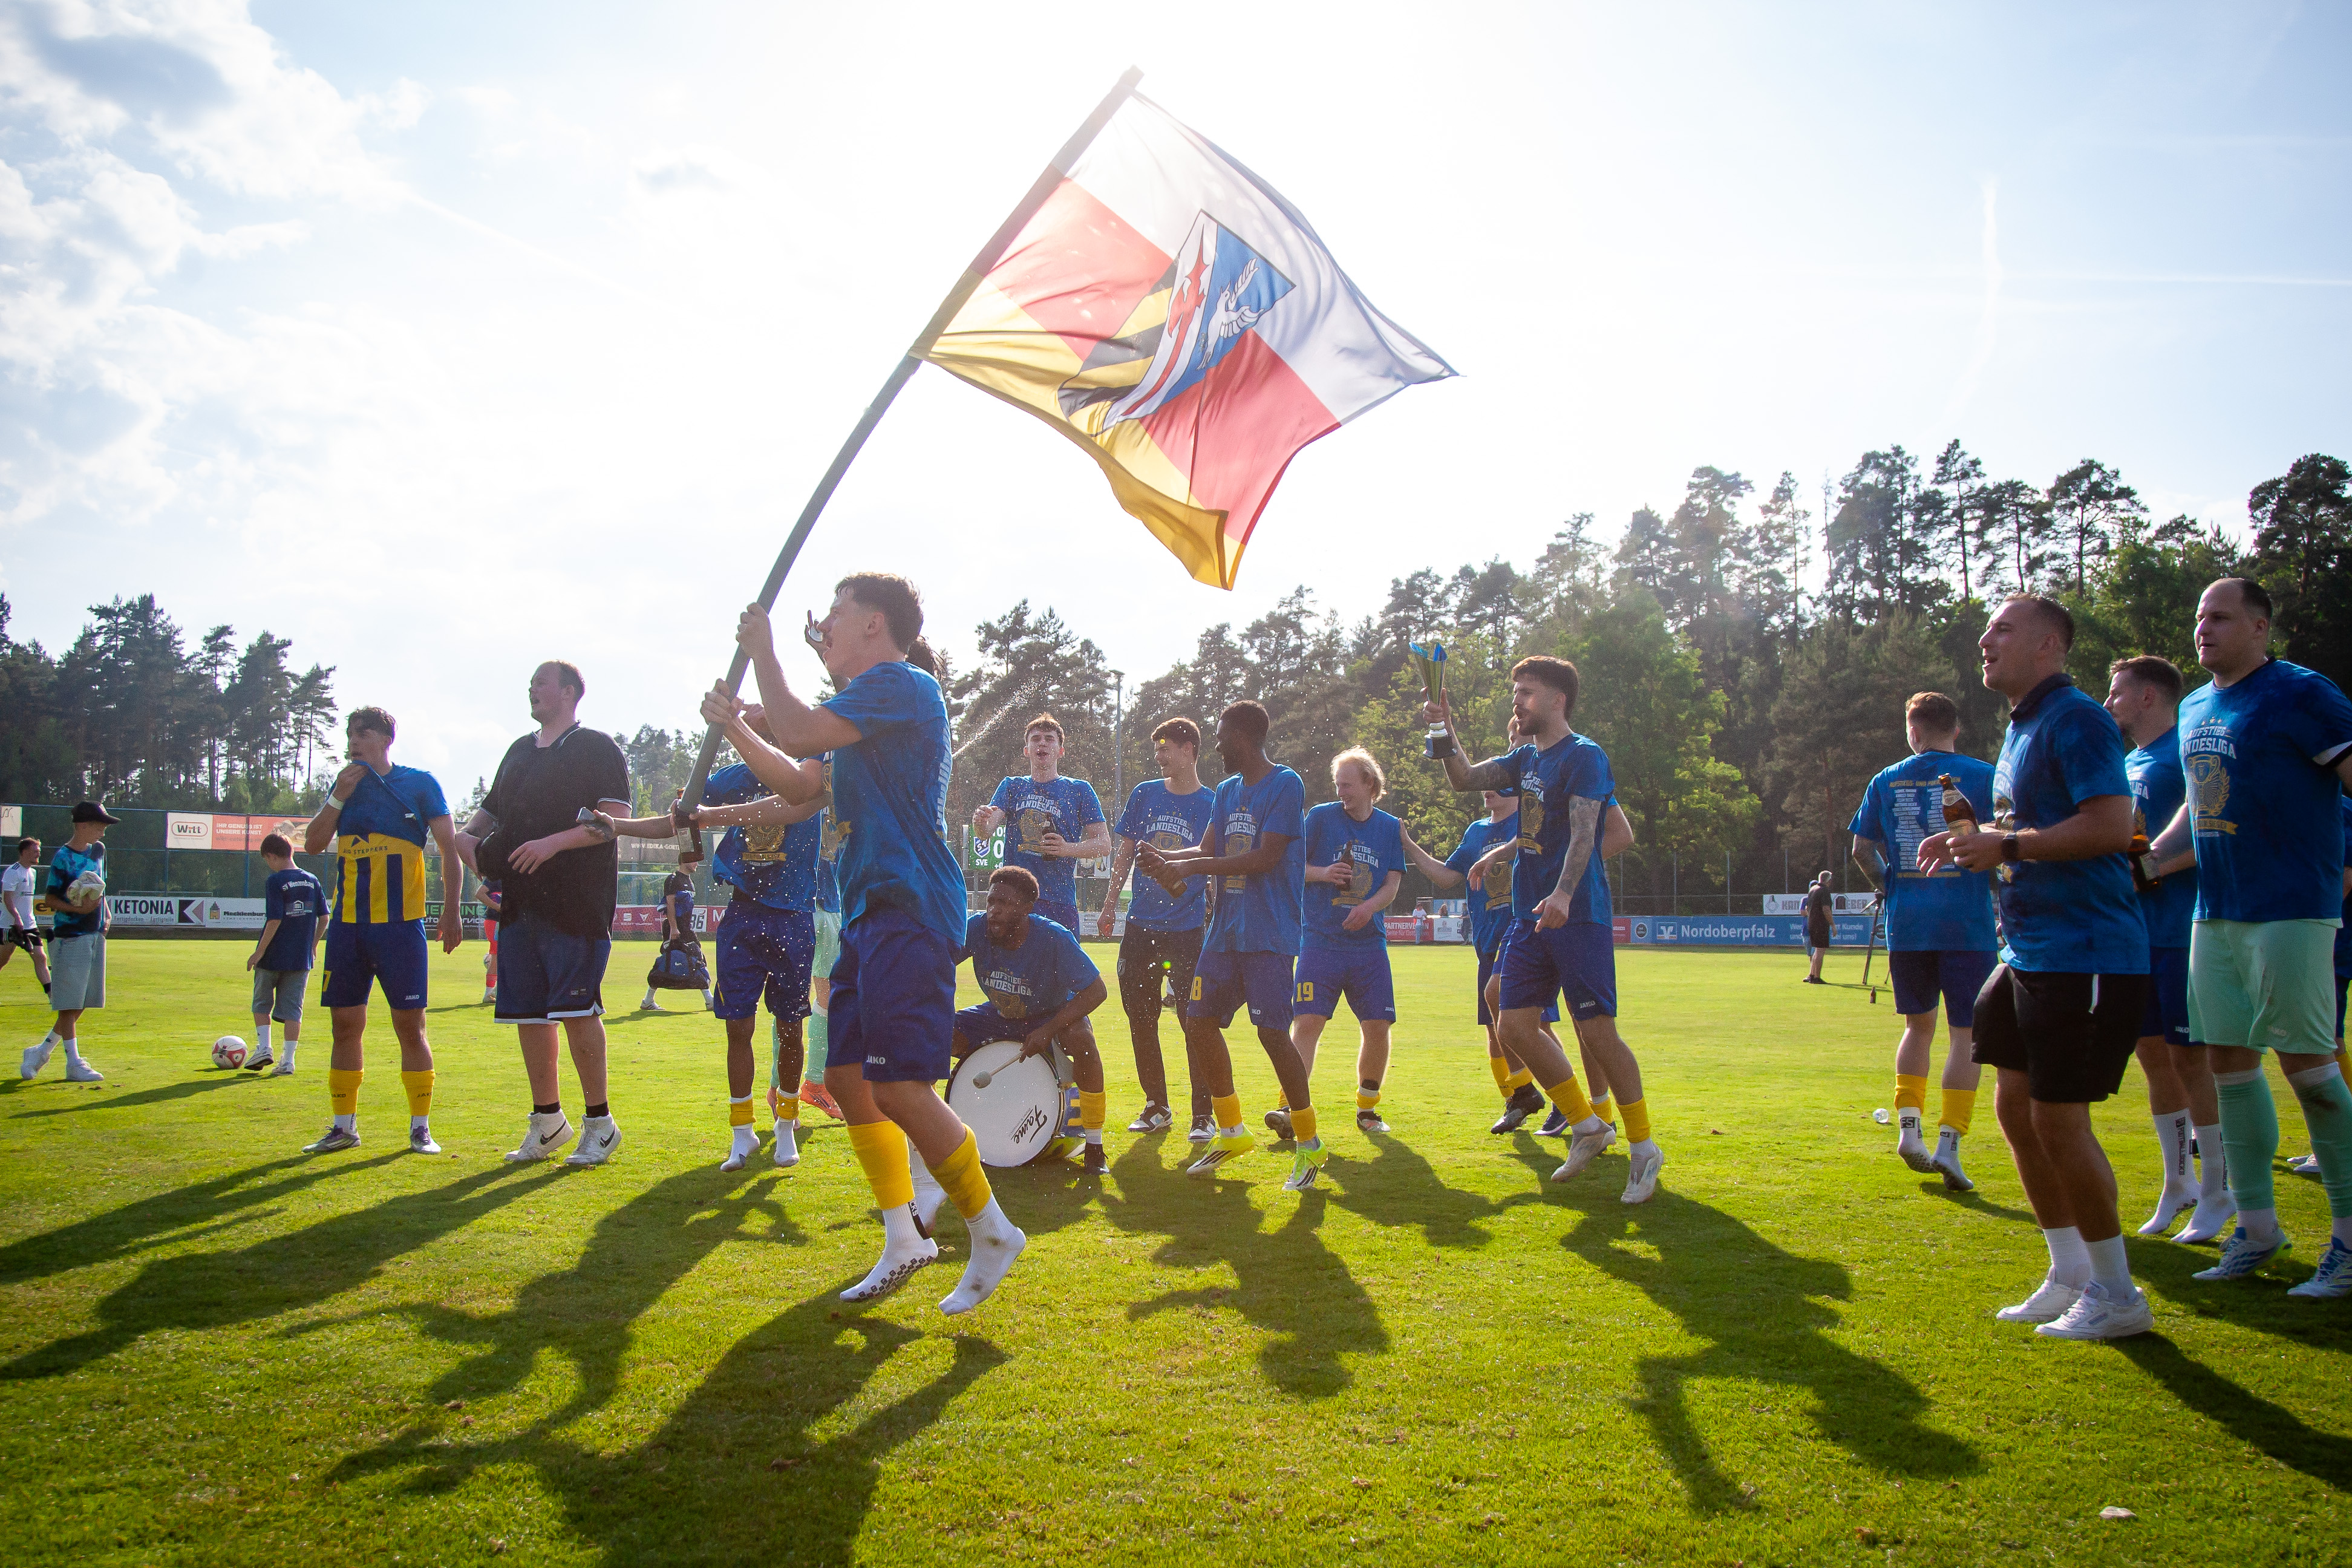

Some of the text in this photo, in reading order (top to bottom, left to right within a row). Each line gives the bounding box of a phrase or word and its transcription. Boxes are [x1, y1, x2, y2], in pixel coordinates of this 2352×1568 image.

[2186, 725, 2226, 740] AUFSTIEG
[2181, 737, 2237, 759] NDESLIGA
[1026, 794, 1055, 806] AUFSTIEG
[1016, 800, 1061, 818] LANDESLIGA
[177, 825, 201, 834] Witt
[1157, 815, 1187, 828] AUFSTIEG
[1225, 822, 1256, 836] ANDESLIG
[1146, 822, 1194, 843] LANDESLIGA
[1343, 843, 1371, 854] ASTIEG
[1333, 850, 1379, 869] LAESLIGA
[114, 899, 174, 915] KETONIA
[1681, 924, 1775, 941] Nordoberpfalz
[990, 971, 1021, 984] AUFSTIEG
[981, 976, 1032, 996] LANDESLIGA
[1296, 982, 1313, 1002] 19
[1580, 1000, 1596, 1009] JAKO
[1014, 1104, 1048, 1144] Fame
